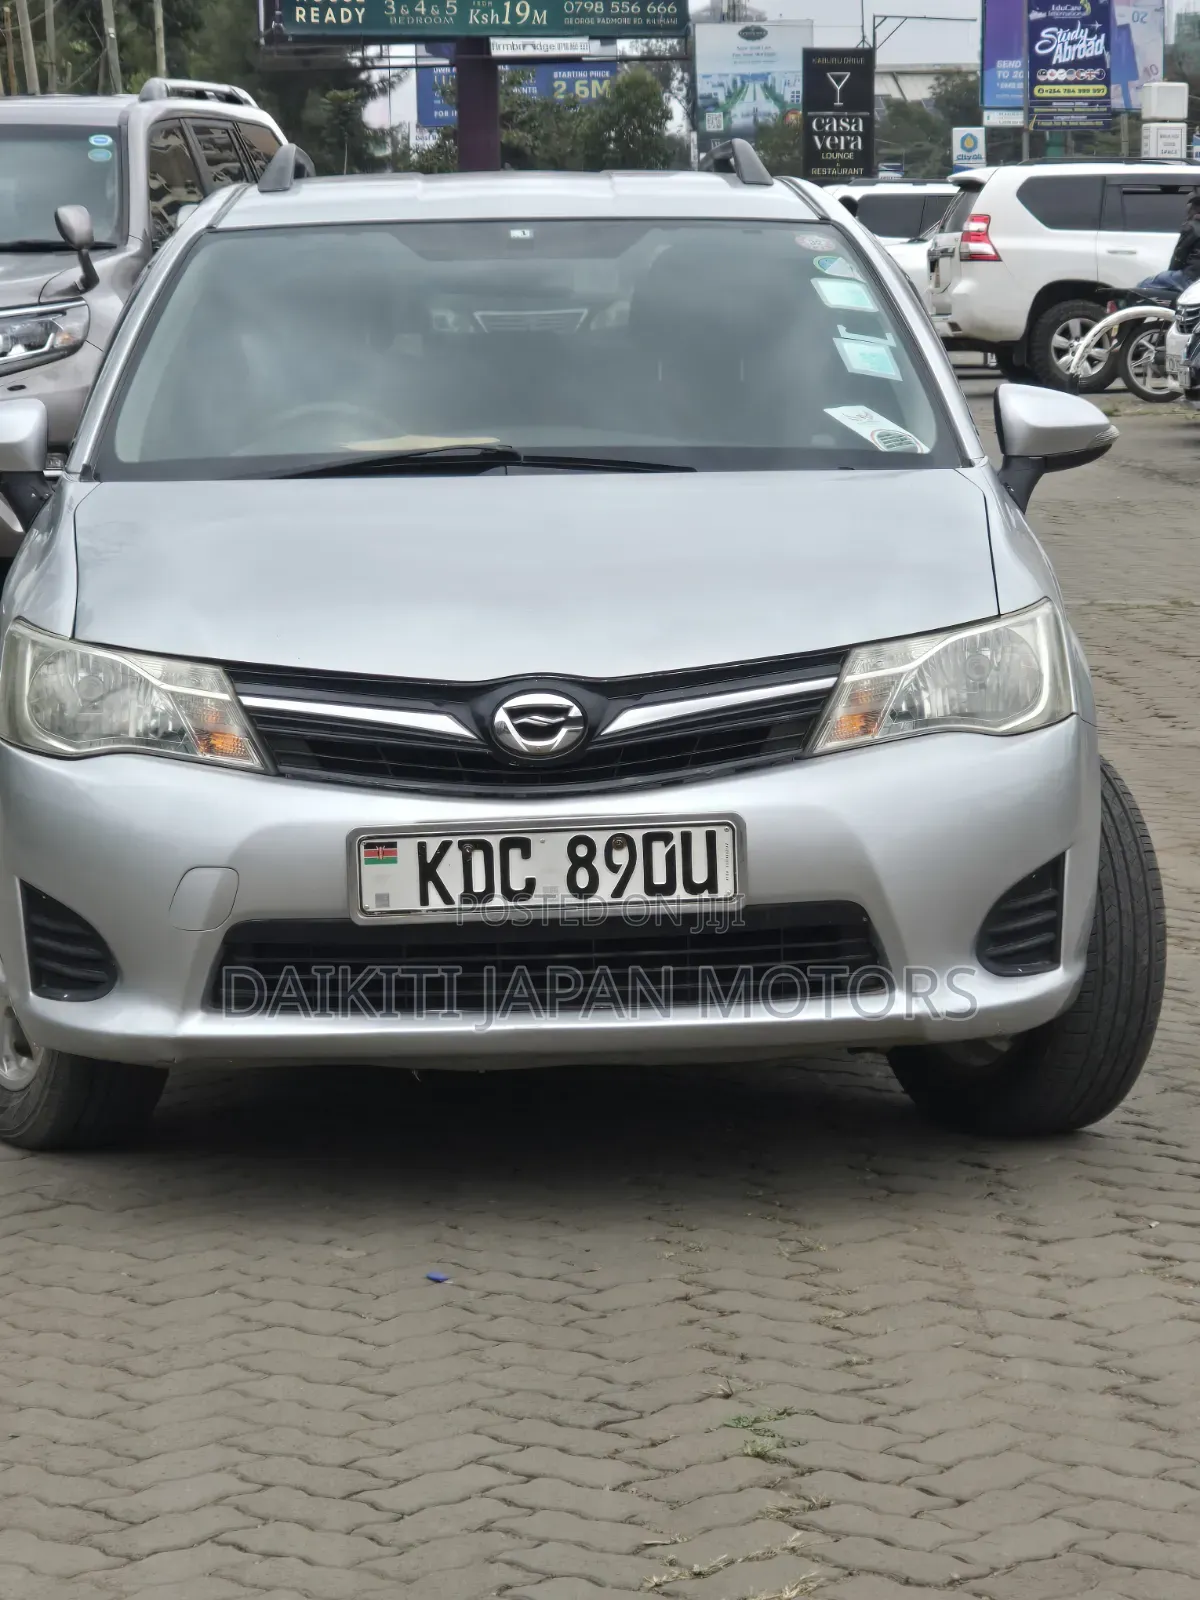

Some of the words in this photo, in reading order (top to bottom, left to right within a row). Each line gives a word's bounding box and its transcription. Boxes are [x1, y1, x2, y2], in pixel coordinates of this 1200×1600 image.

[384, 0, 396, 15] 3
[400, 5, 409, 15] &
[414, 0, 427, 15] 4
[430, 5, 440, 15] &
[445, 0, 458, 15] 5
[563, 1, 604, 14] 0798
[610, 1, 641, 14] 556
[646, 1, 677, 14] 666
[295, 6, 366, 25] READY
[390, 16, 455, 25] BEDROOM
[564, 17, 594, 25] GEORGE
[1035, 20, 1092, 54] Study
[1052, 33, 1106, 65] Abroad
[811, 116, 864, 132] casa
[813, 135, 863, 150] vera
[821, 152, 855, 160] LOUNGE
[811, 167, 864, 175] RESTAURANT
[417, 837, 537, 907] KDC
[566, 829, 720, 900] 890U
